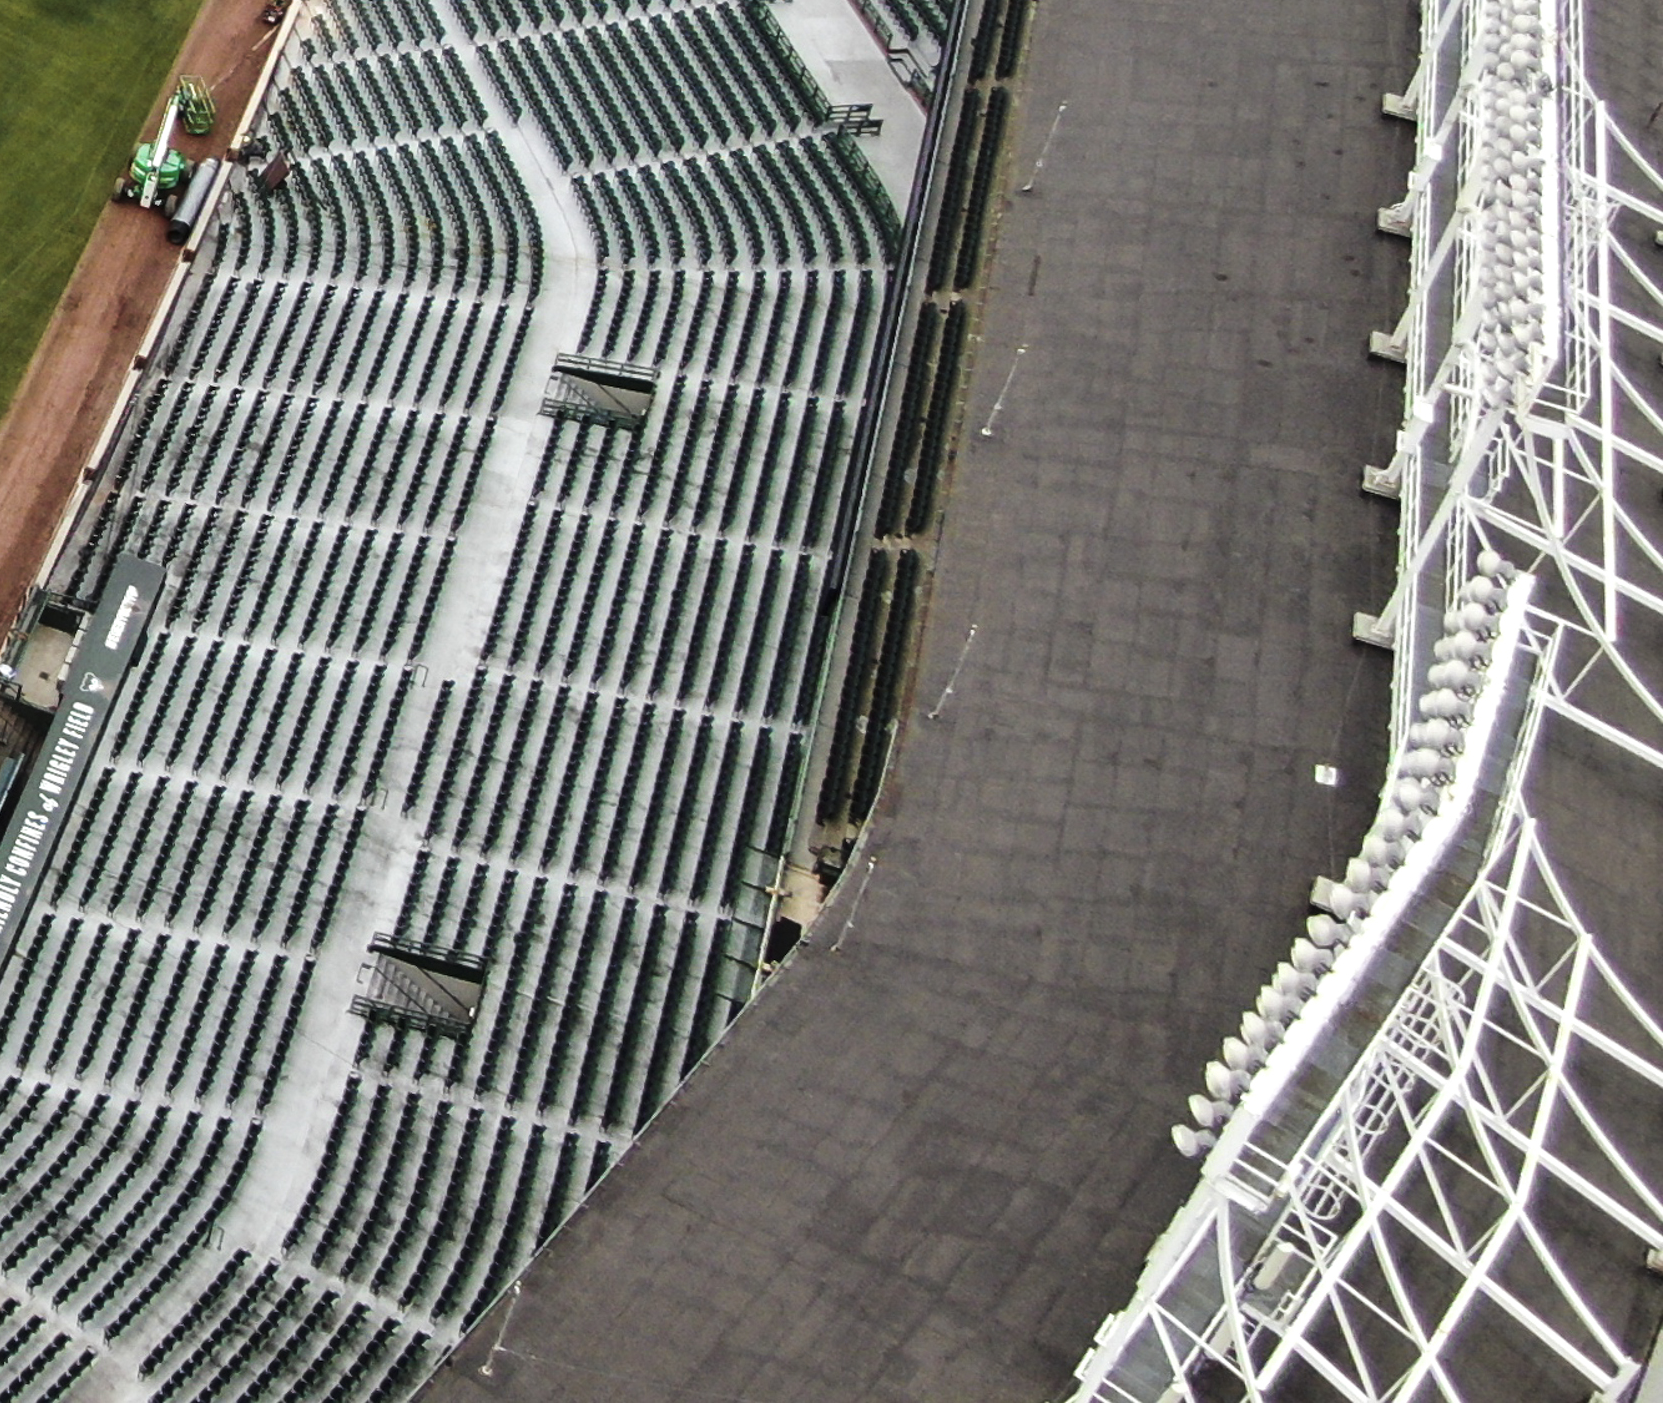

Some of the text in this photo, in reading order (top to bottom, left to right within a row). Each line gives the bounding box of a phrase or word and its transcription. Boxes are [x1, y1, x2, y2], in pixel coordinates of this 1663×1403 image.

[7, 810, 48, 877] CONFINES
[38, 738, 78, 794] WRIGLEY
[63, 700, 95, 741] FIELD
